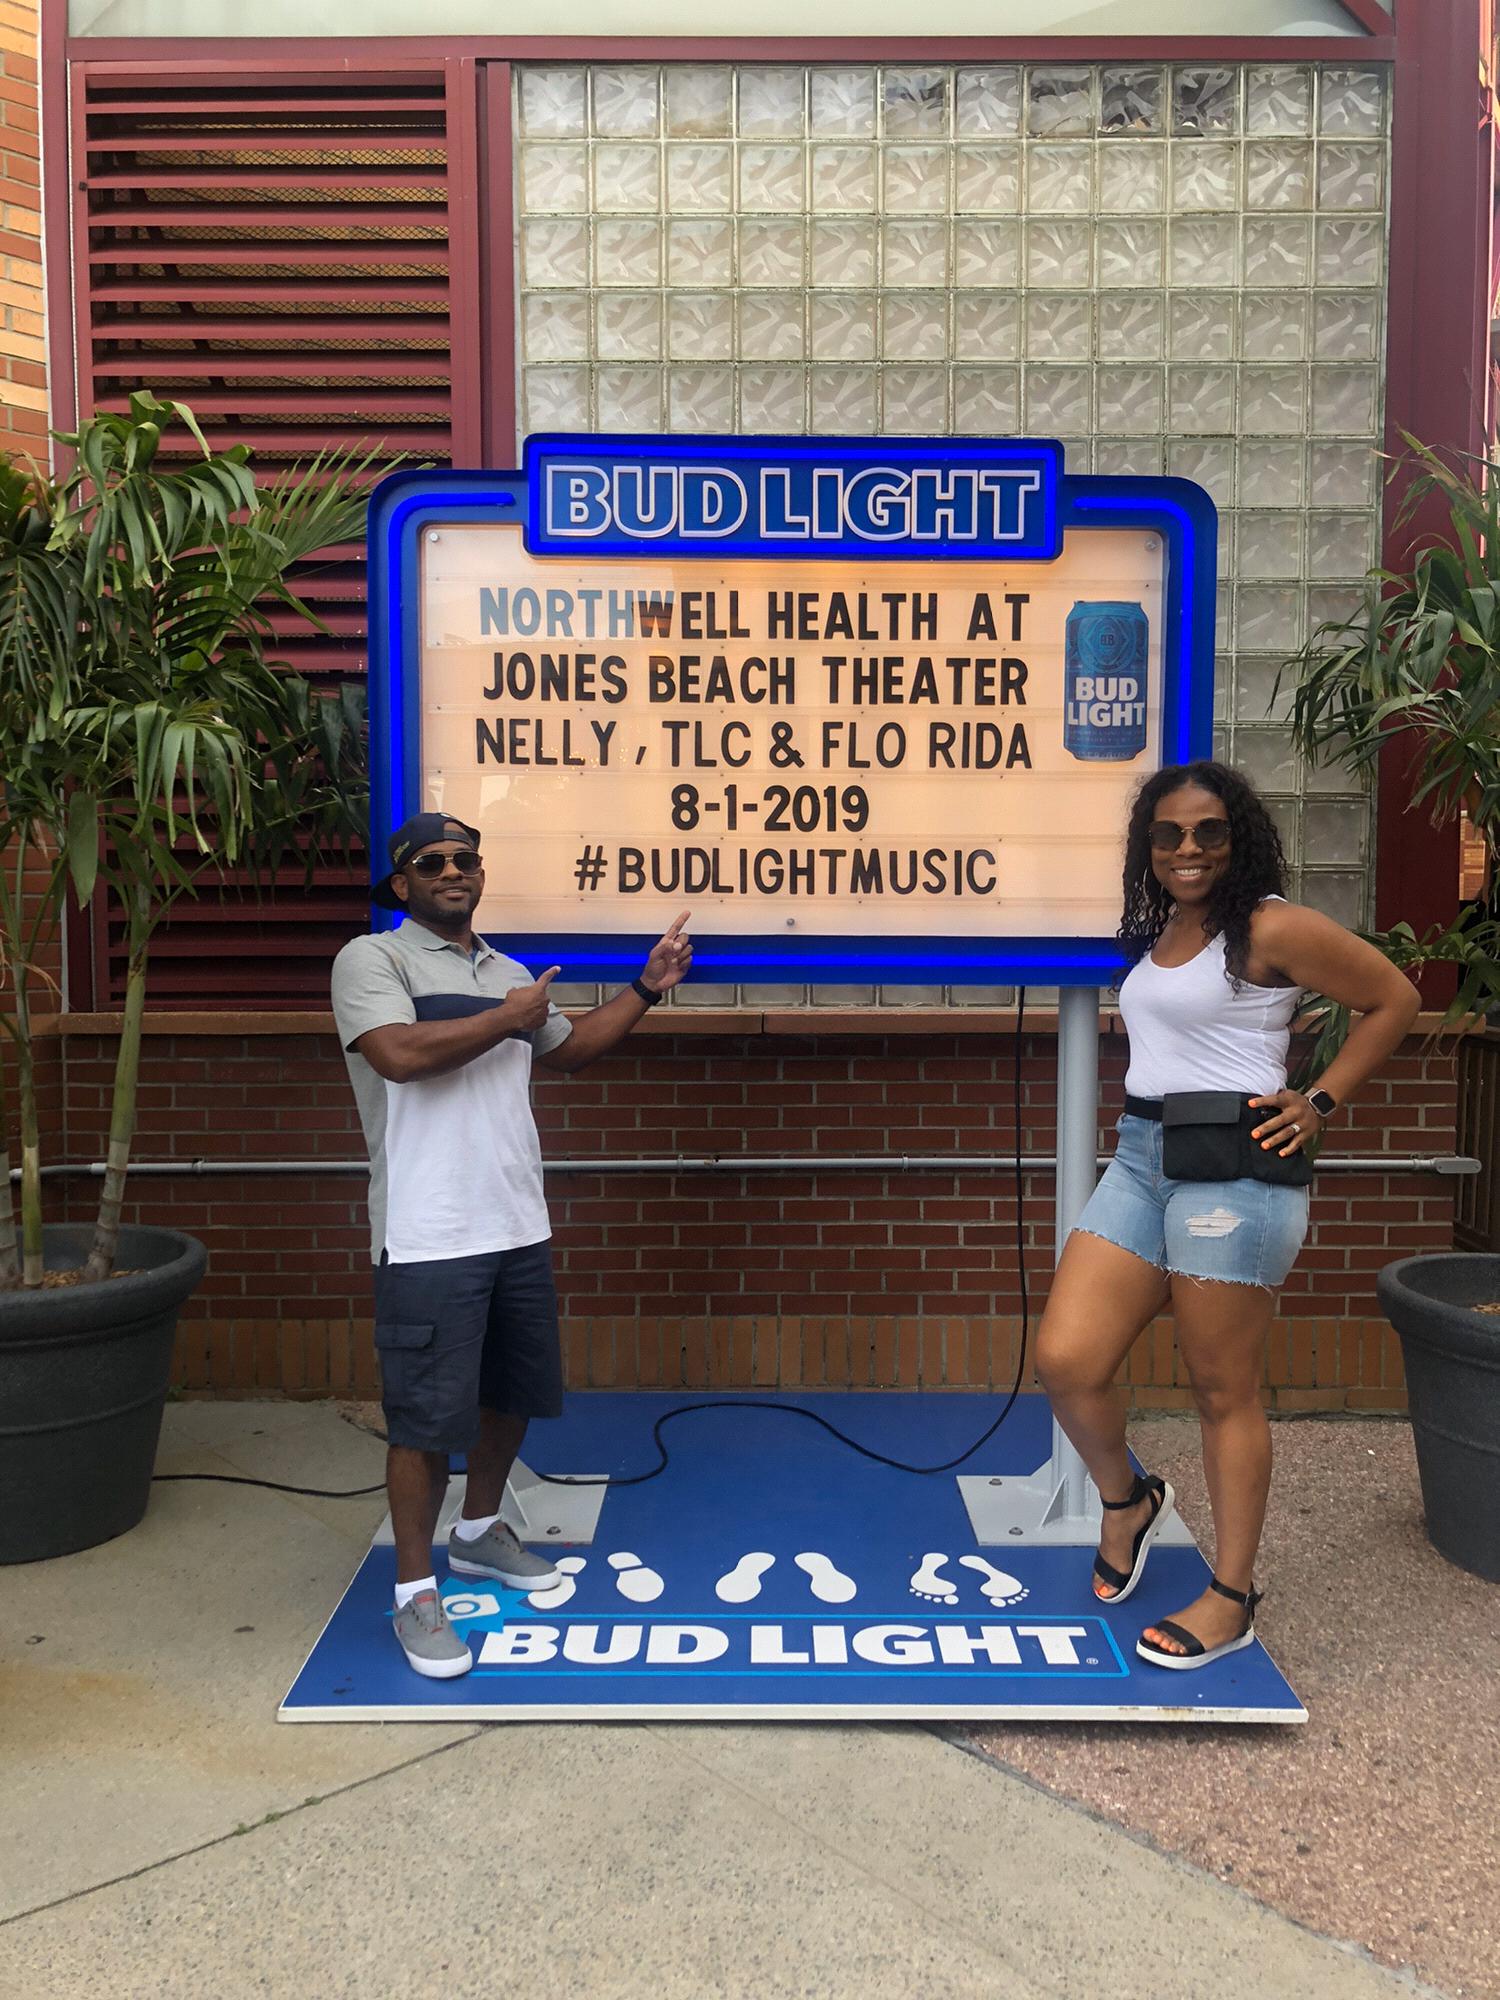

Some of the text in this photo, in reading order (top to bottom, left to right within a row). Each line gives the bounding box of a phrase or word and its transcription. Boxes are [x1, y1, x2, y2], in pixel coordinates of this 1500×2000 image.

[545, 464, 1041, 541] BUD LIGHT
[479, 586, 1031, 642] NORTHWELL HEALTH AT
[483, 652, 1030, 707] JONES BEACH THEATER
[1075, 676, 1139, 702] BUD
[1067, 701, 1145, 728] LIGHT
[661, 720, 752, 768] TLC
[768, 721, 806, 768] &
[821, 721, 907, 768] FLO
[928, 722, 1033, 770] RIDA
[670, 783, 870, 833] 8-1-2019
[573, 844, 998, 896] #BUDLIGHTMUSIC
[476, 1623, 1088, 1665] BUD LIGHT
